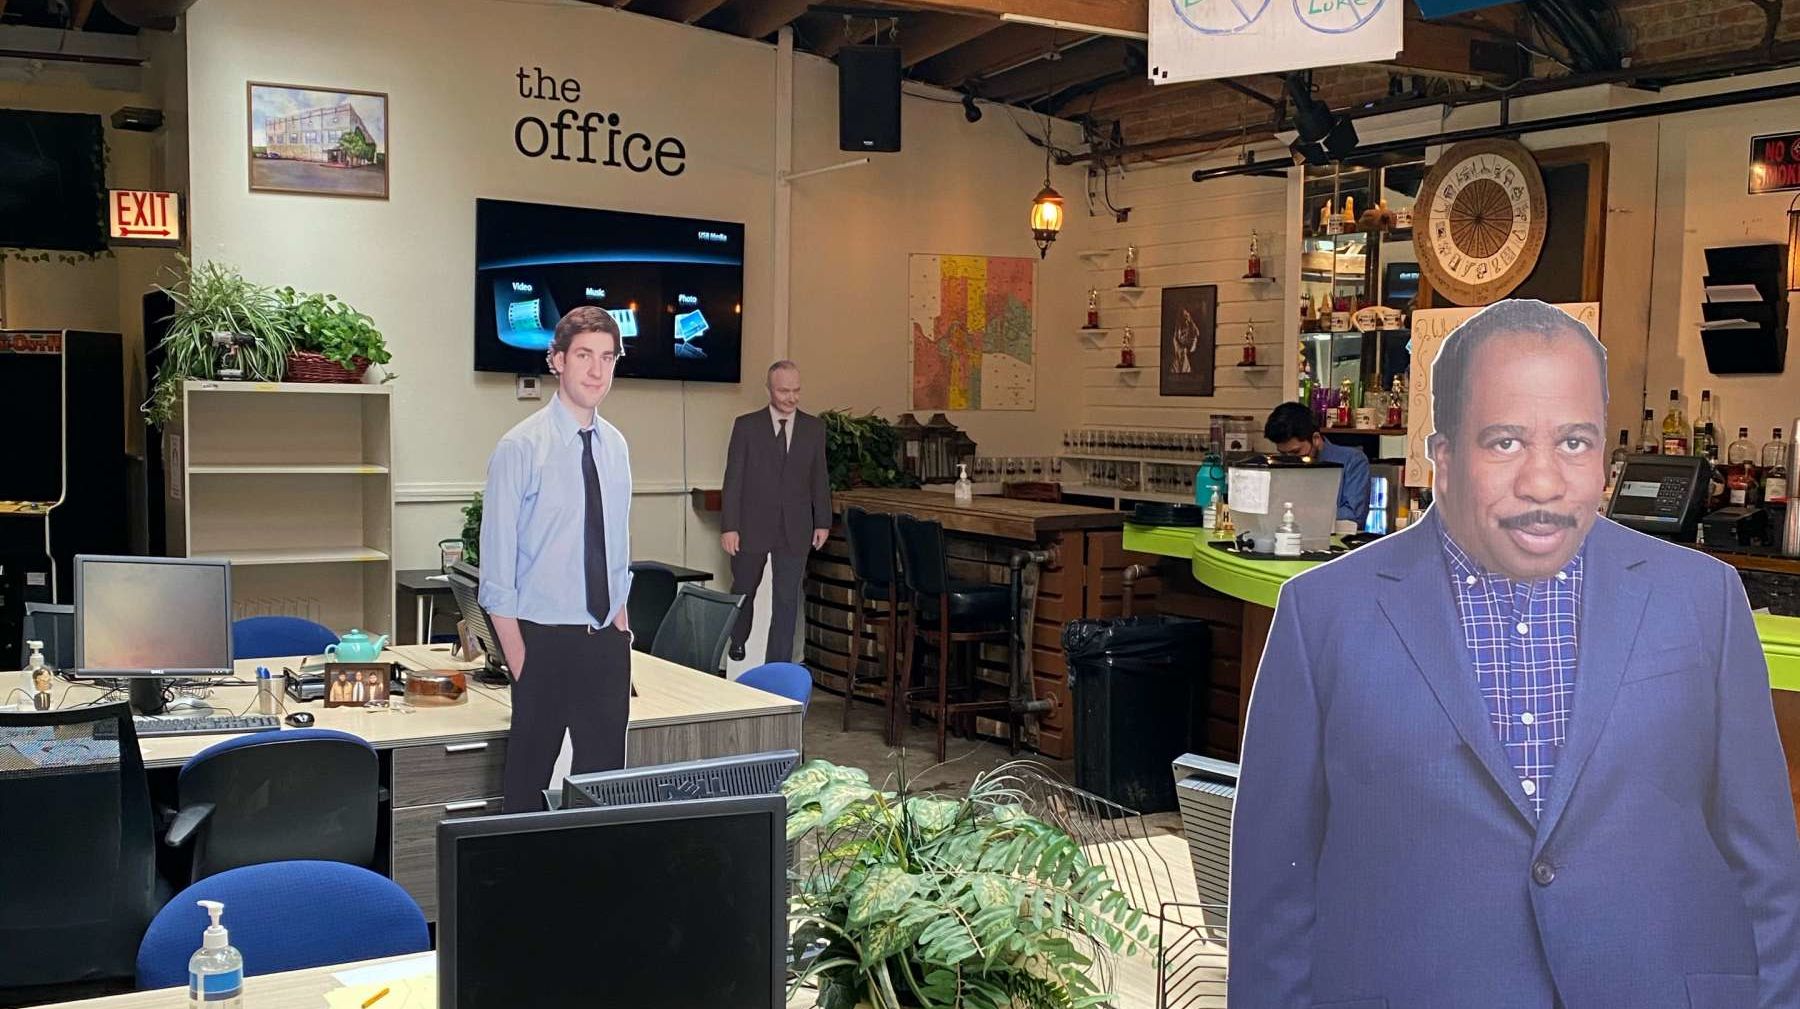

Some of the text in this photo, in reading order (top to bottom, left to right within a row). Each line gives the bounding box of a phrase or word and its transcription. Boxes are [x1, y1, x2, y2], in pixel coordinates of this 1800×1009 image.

[516, 67, 581, 103] the
[515, 109, 686, 176] office
[1765, 140, 1785, 162] NO
[1752, 163, 1800, 188] SMOK
[117, 192, 170, 226] EXIT
[512, 282, 533, 292] Video
[585, 287, 606, 297] Music
[678, 294, 698, 304] Photo
